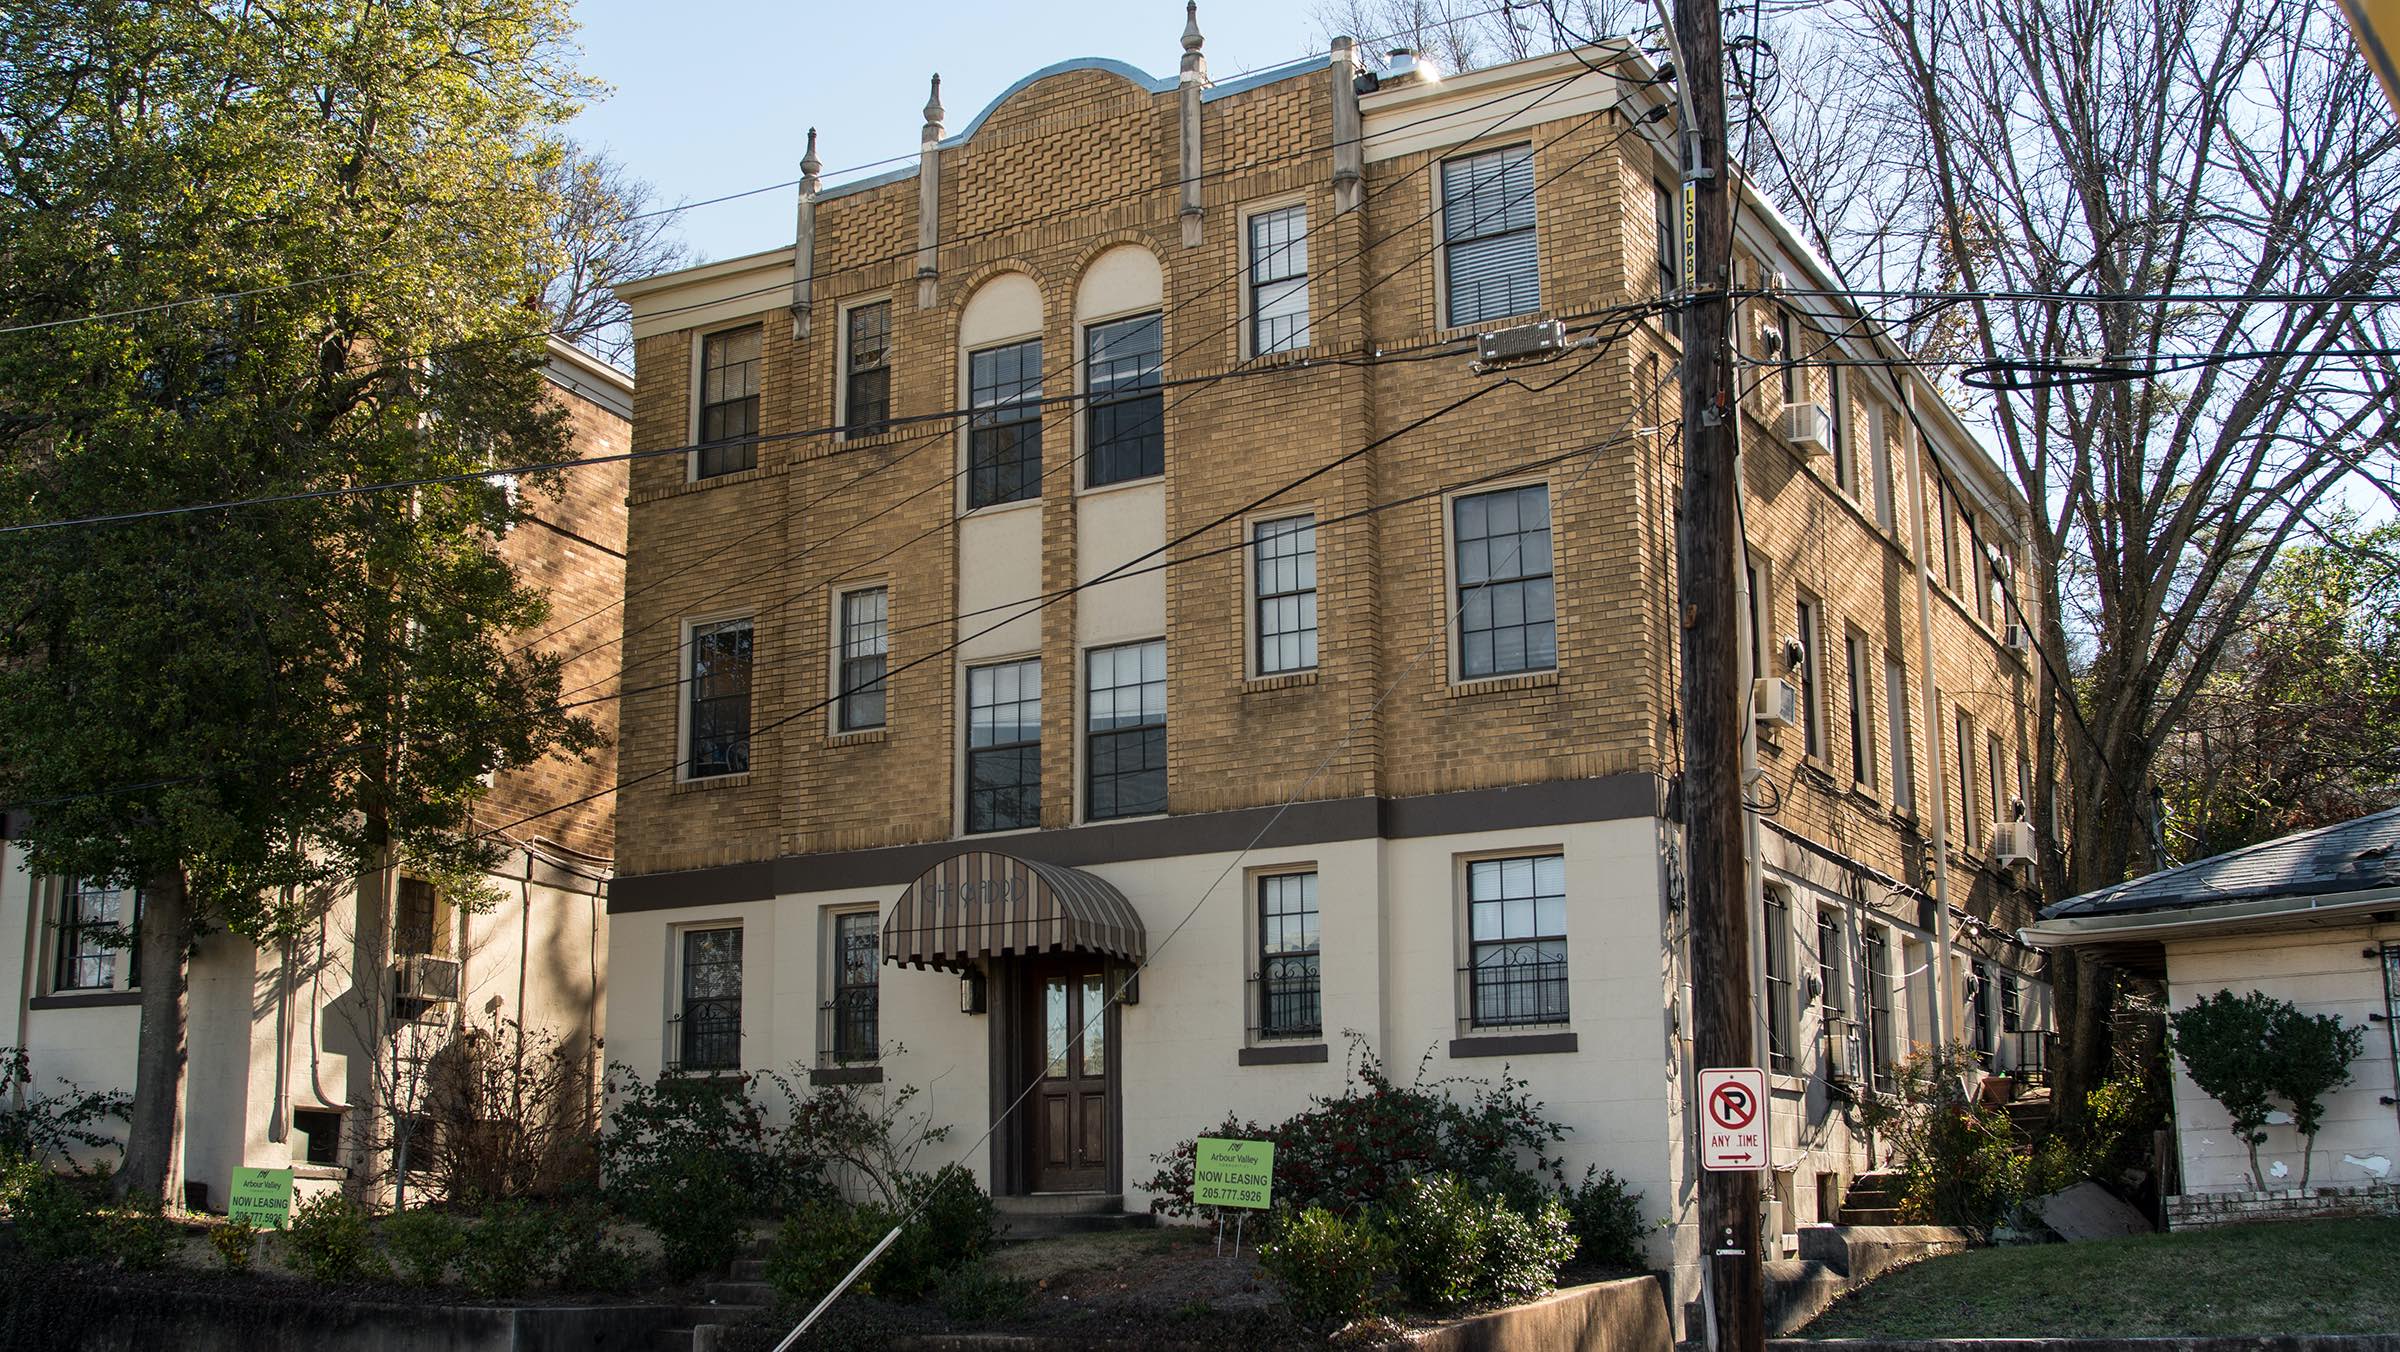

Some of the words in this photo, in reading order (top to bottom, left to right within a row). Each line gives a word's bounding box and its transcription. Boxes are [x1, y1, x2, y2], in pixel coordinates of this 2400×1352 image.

[1711, 1134, 1731, 1148] ANY
[1737, 1134, 1758, 1147] TIME
[1210, 1152, 1236, 1163] Arbour
[1237, 1154, 1259, 1166] Valley
[1198, 1170, 1223, 1183] NOW
[1225, 1172, 1268, 1186] LEASING
[242, 1180, 264, 1188] Arbour
[264, 1181, 282, 1192] Valley
[1202, 1186, 1262, 1202] 205.777.5926
[232, 1195, 252, 1207] NOW
[253, 1197, 289, 1209] LEASING
